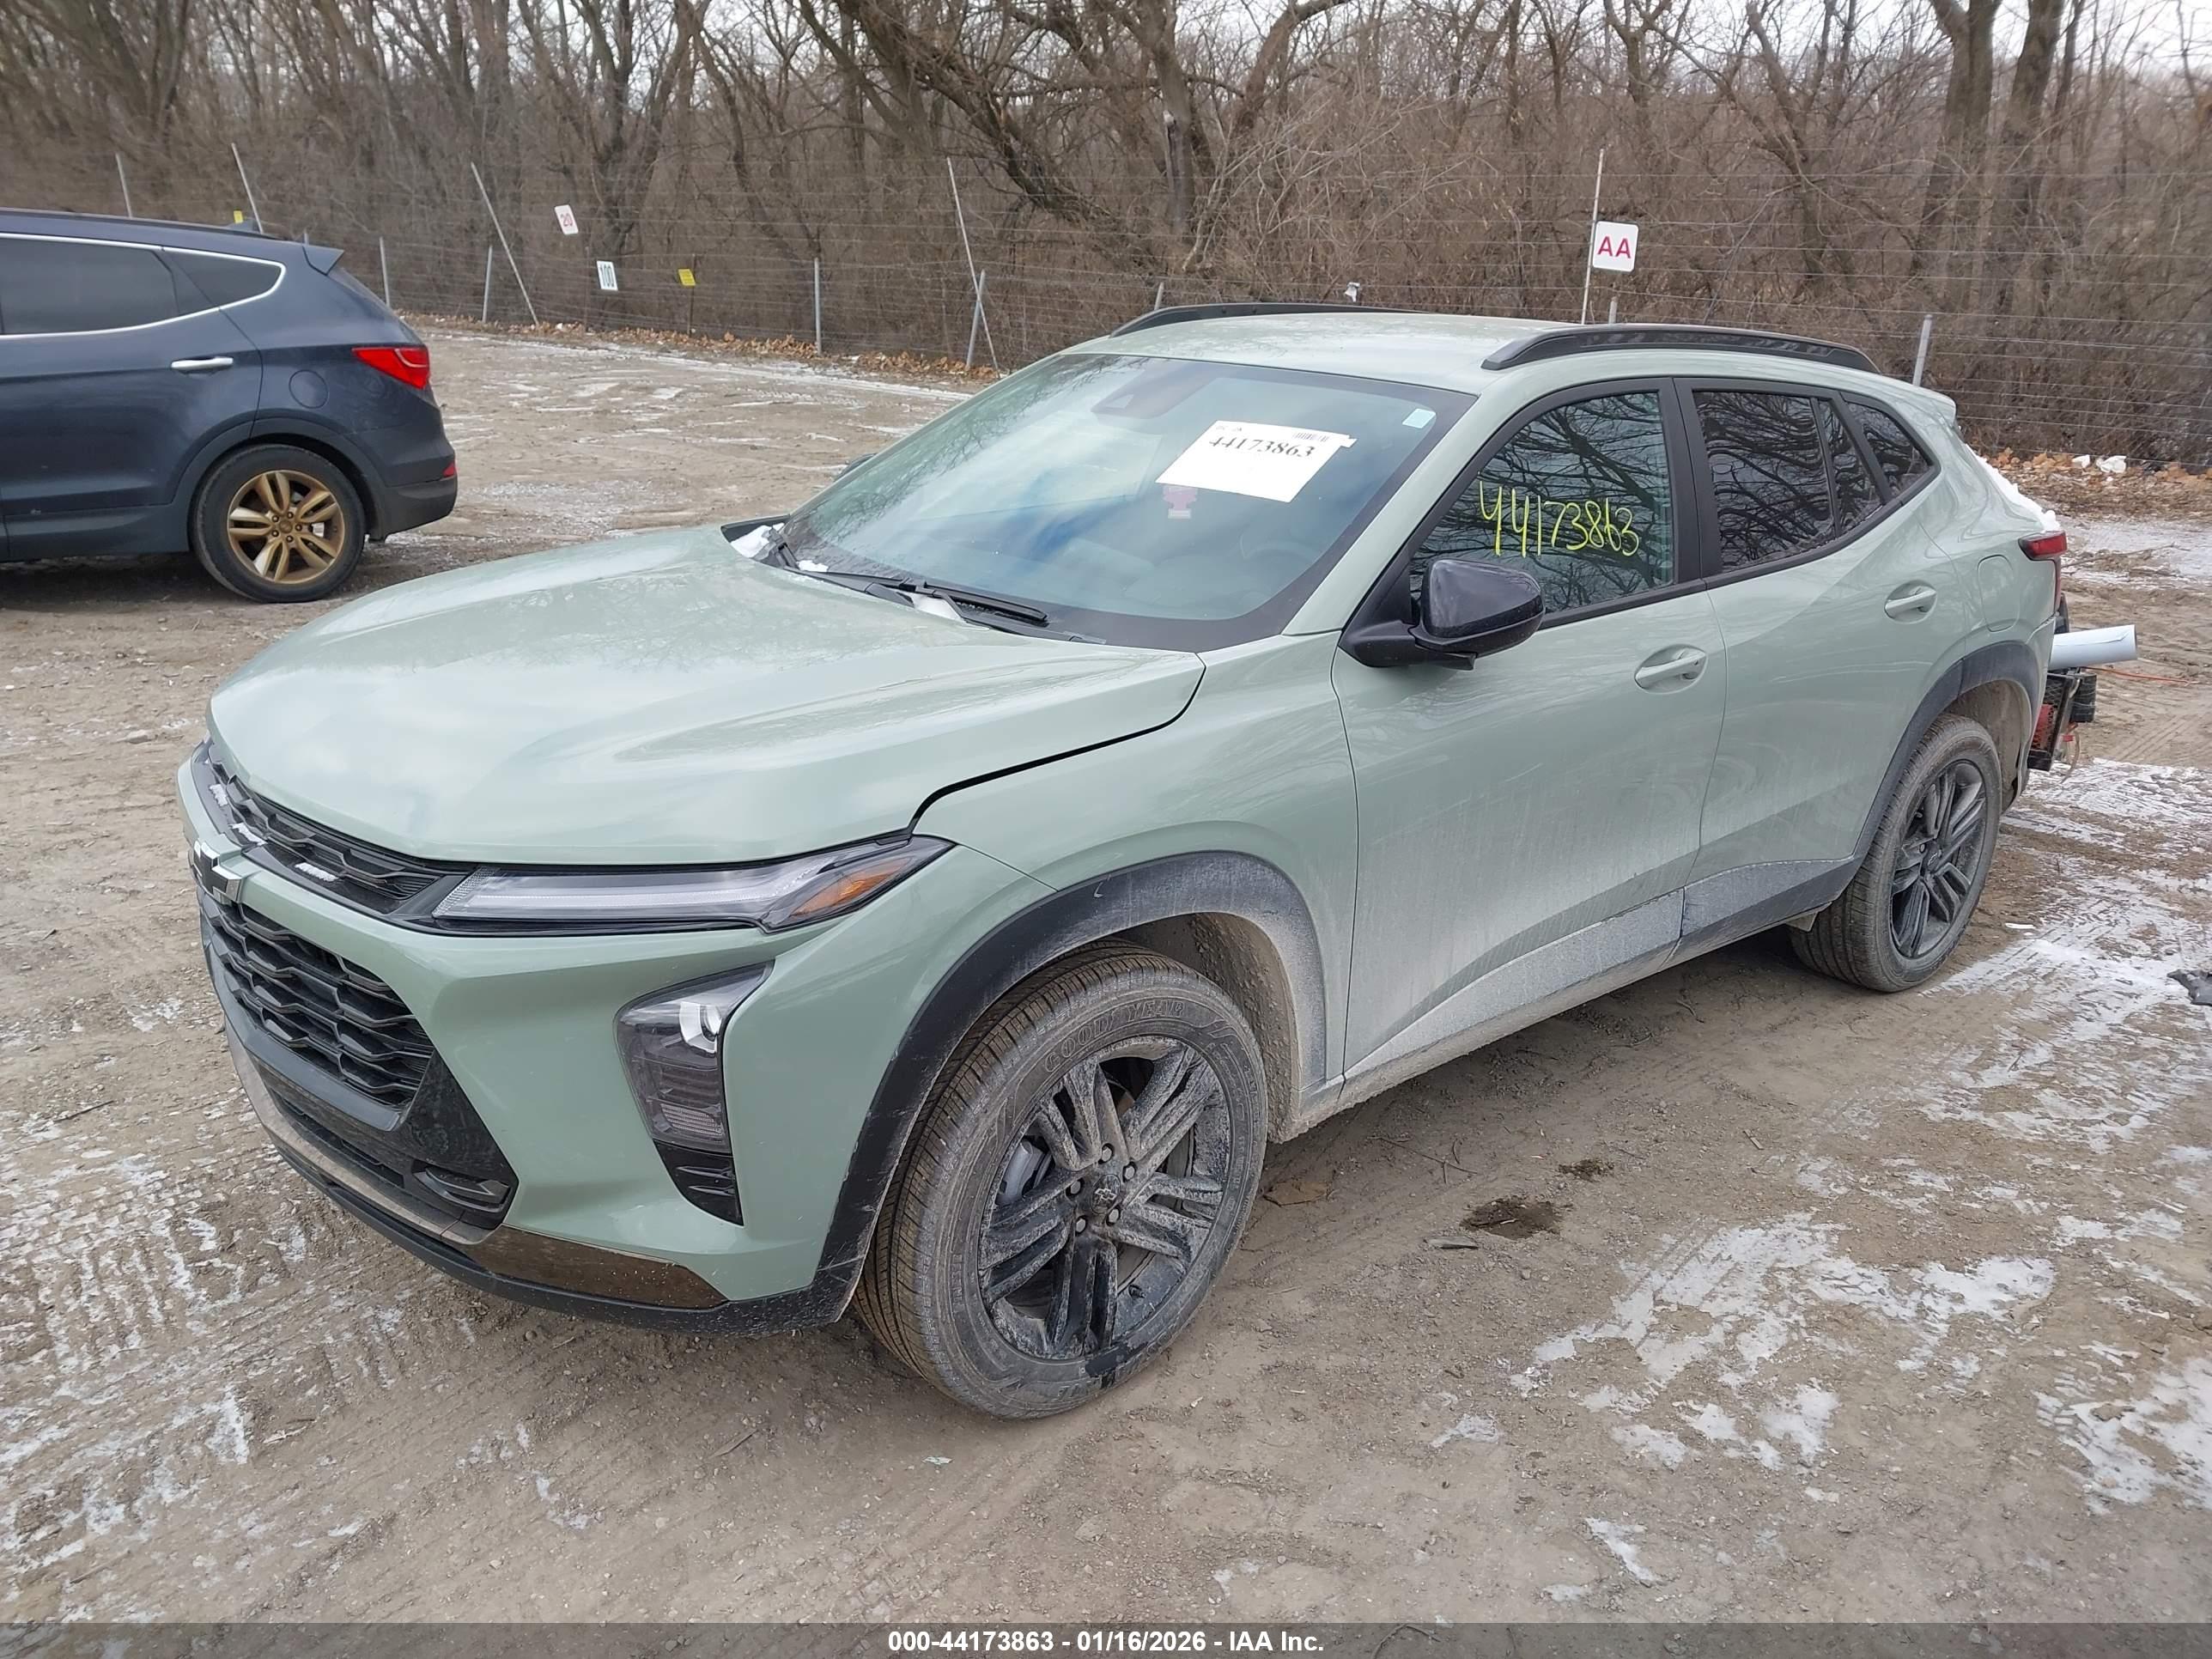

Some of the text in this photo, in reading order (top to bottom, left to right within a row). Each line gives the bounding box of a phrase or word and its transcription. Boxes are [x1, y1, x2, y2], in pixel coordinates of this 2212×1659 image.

[1597, 235, 1632, 258] AA
[1208, 436, 1316, 458] 44173863
[1478, 480, 1639, 558] 44173863
